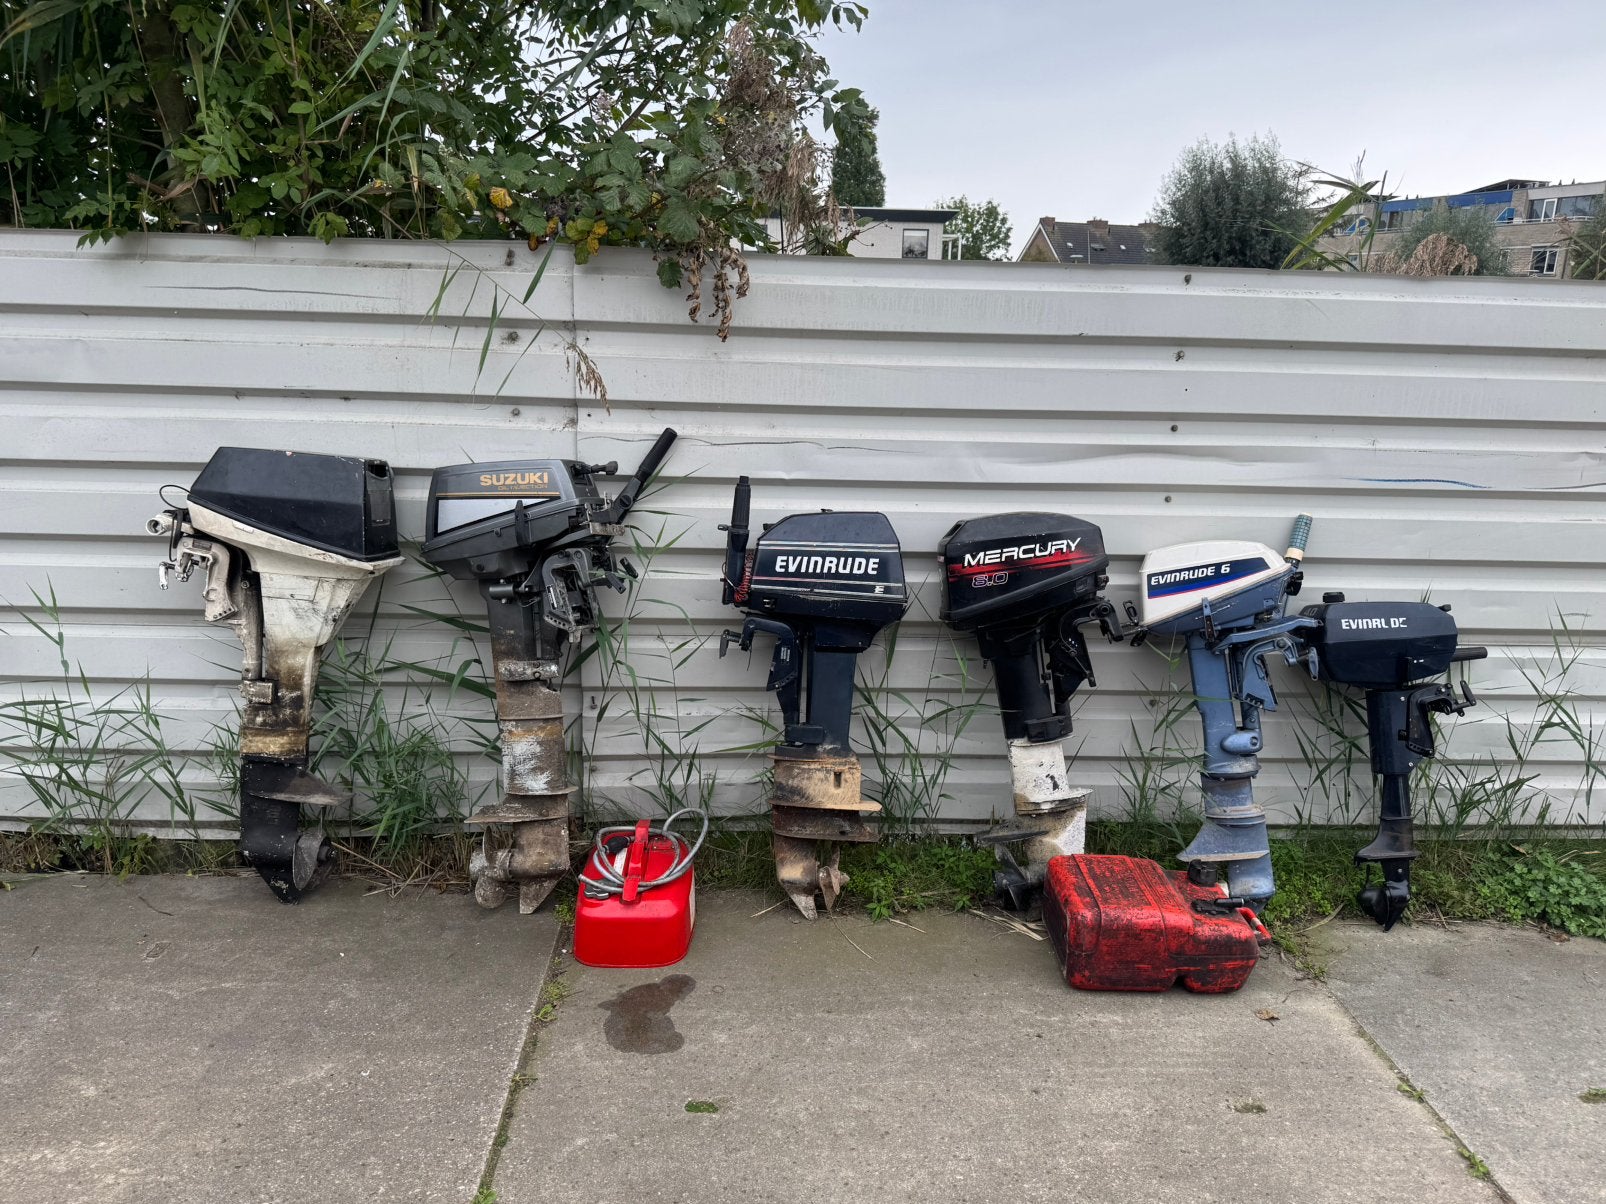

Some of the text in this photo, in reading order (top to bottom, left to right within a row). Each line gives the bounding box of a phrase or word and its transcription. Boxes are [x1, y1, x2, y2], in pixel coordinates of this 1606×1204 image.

[480, 472, 549, 486] SUZUKI
[964, 537, 1082, 567] MERCURY
[775, 555, 880, 575] EVINRUDE
[1150, 563, 1231, 586] EVINRUDE 6
[972, 571, 1009, 588] 8.0
